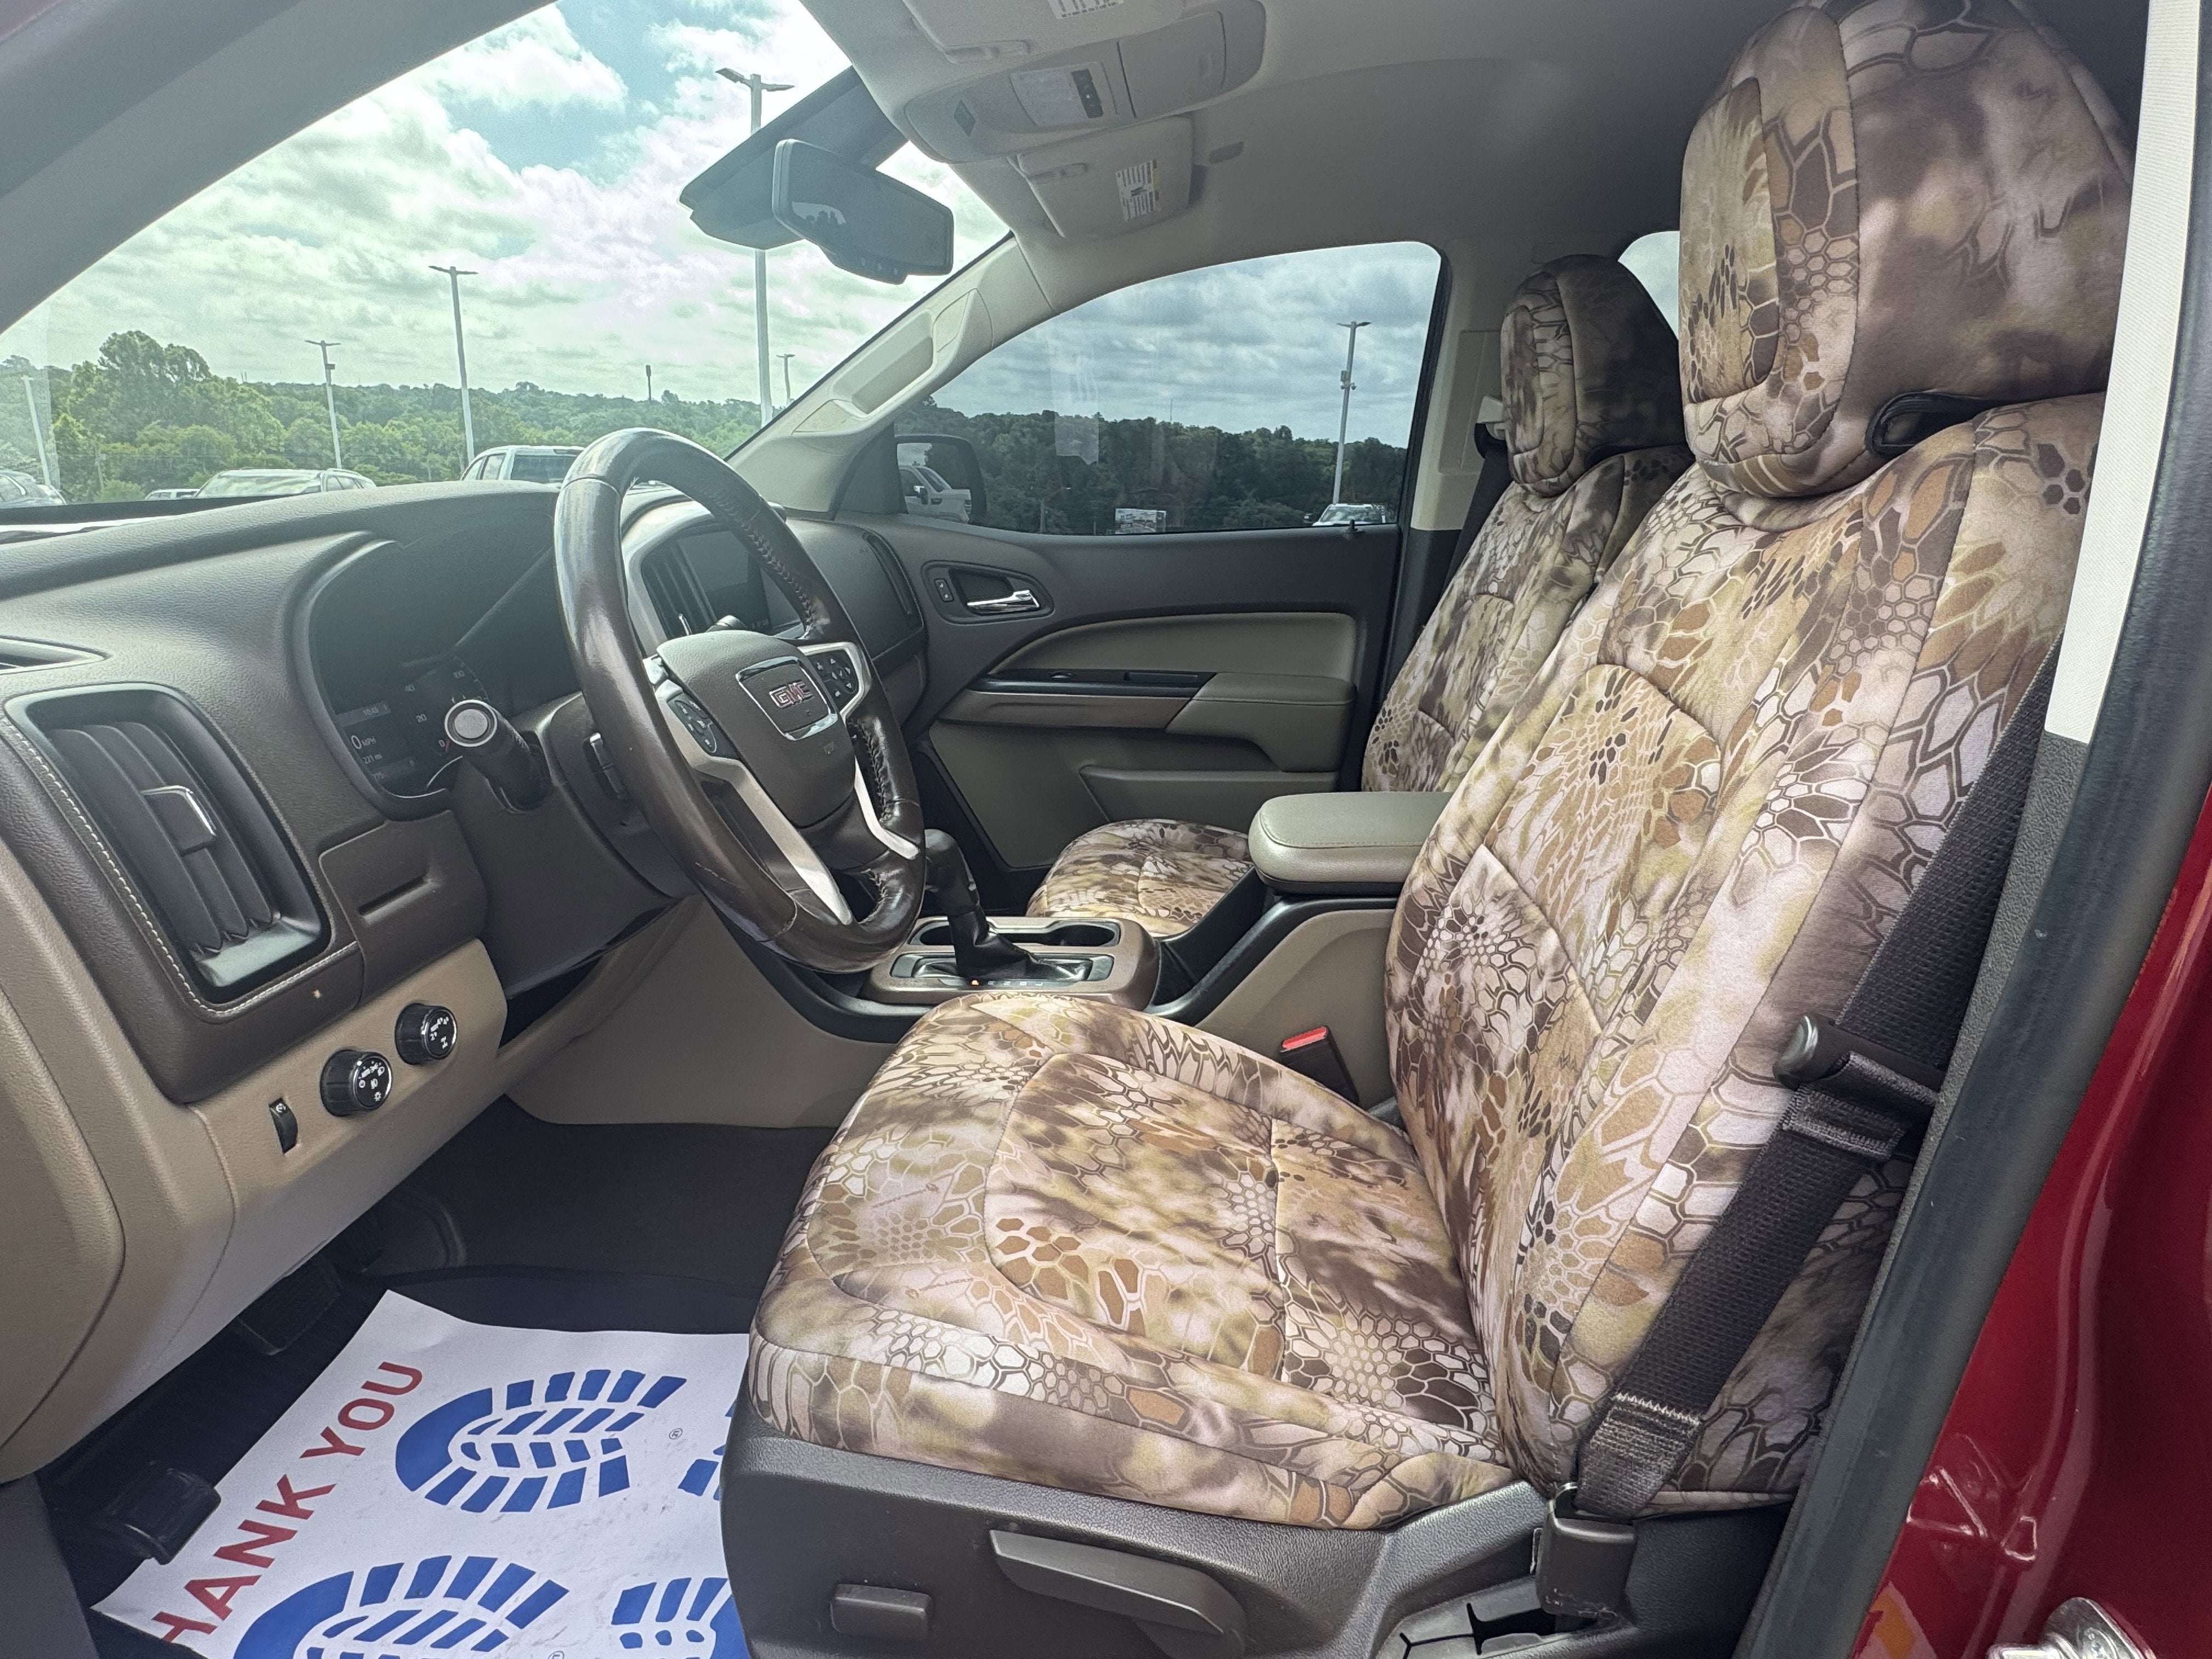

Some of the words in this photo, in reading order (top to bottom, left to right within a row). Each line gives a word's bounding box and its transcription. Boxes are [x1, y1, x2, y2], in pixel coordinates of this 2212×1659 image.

[769, 681, 813, 709] GMC
[416, 714, 427, 723] 20
[351, 735, 362, 749] 0
[299, 1361, 423, 1459] YOU
